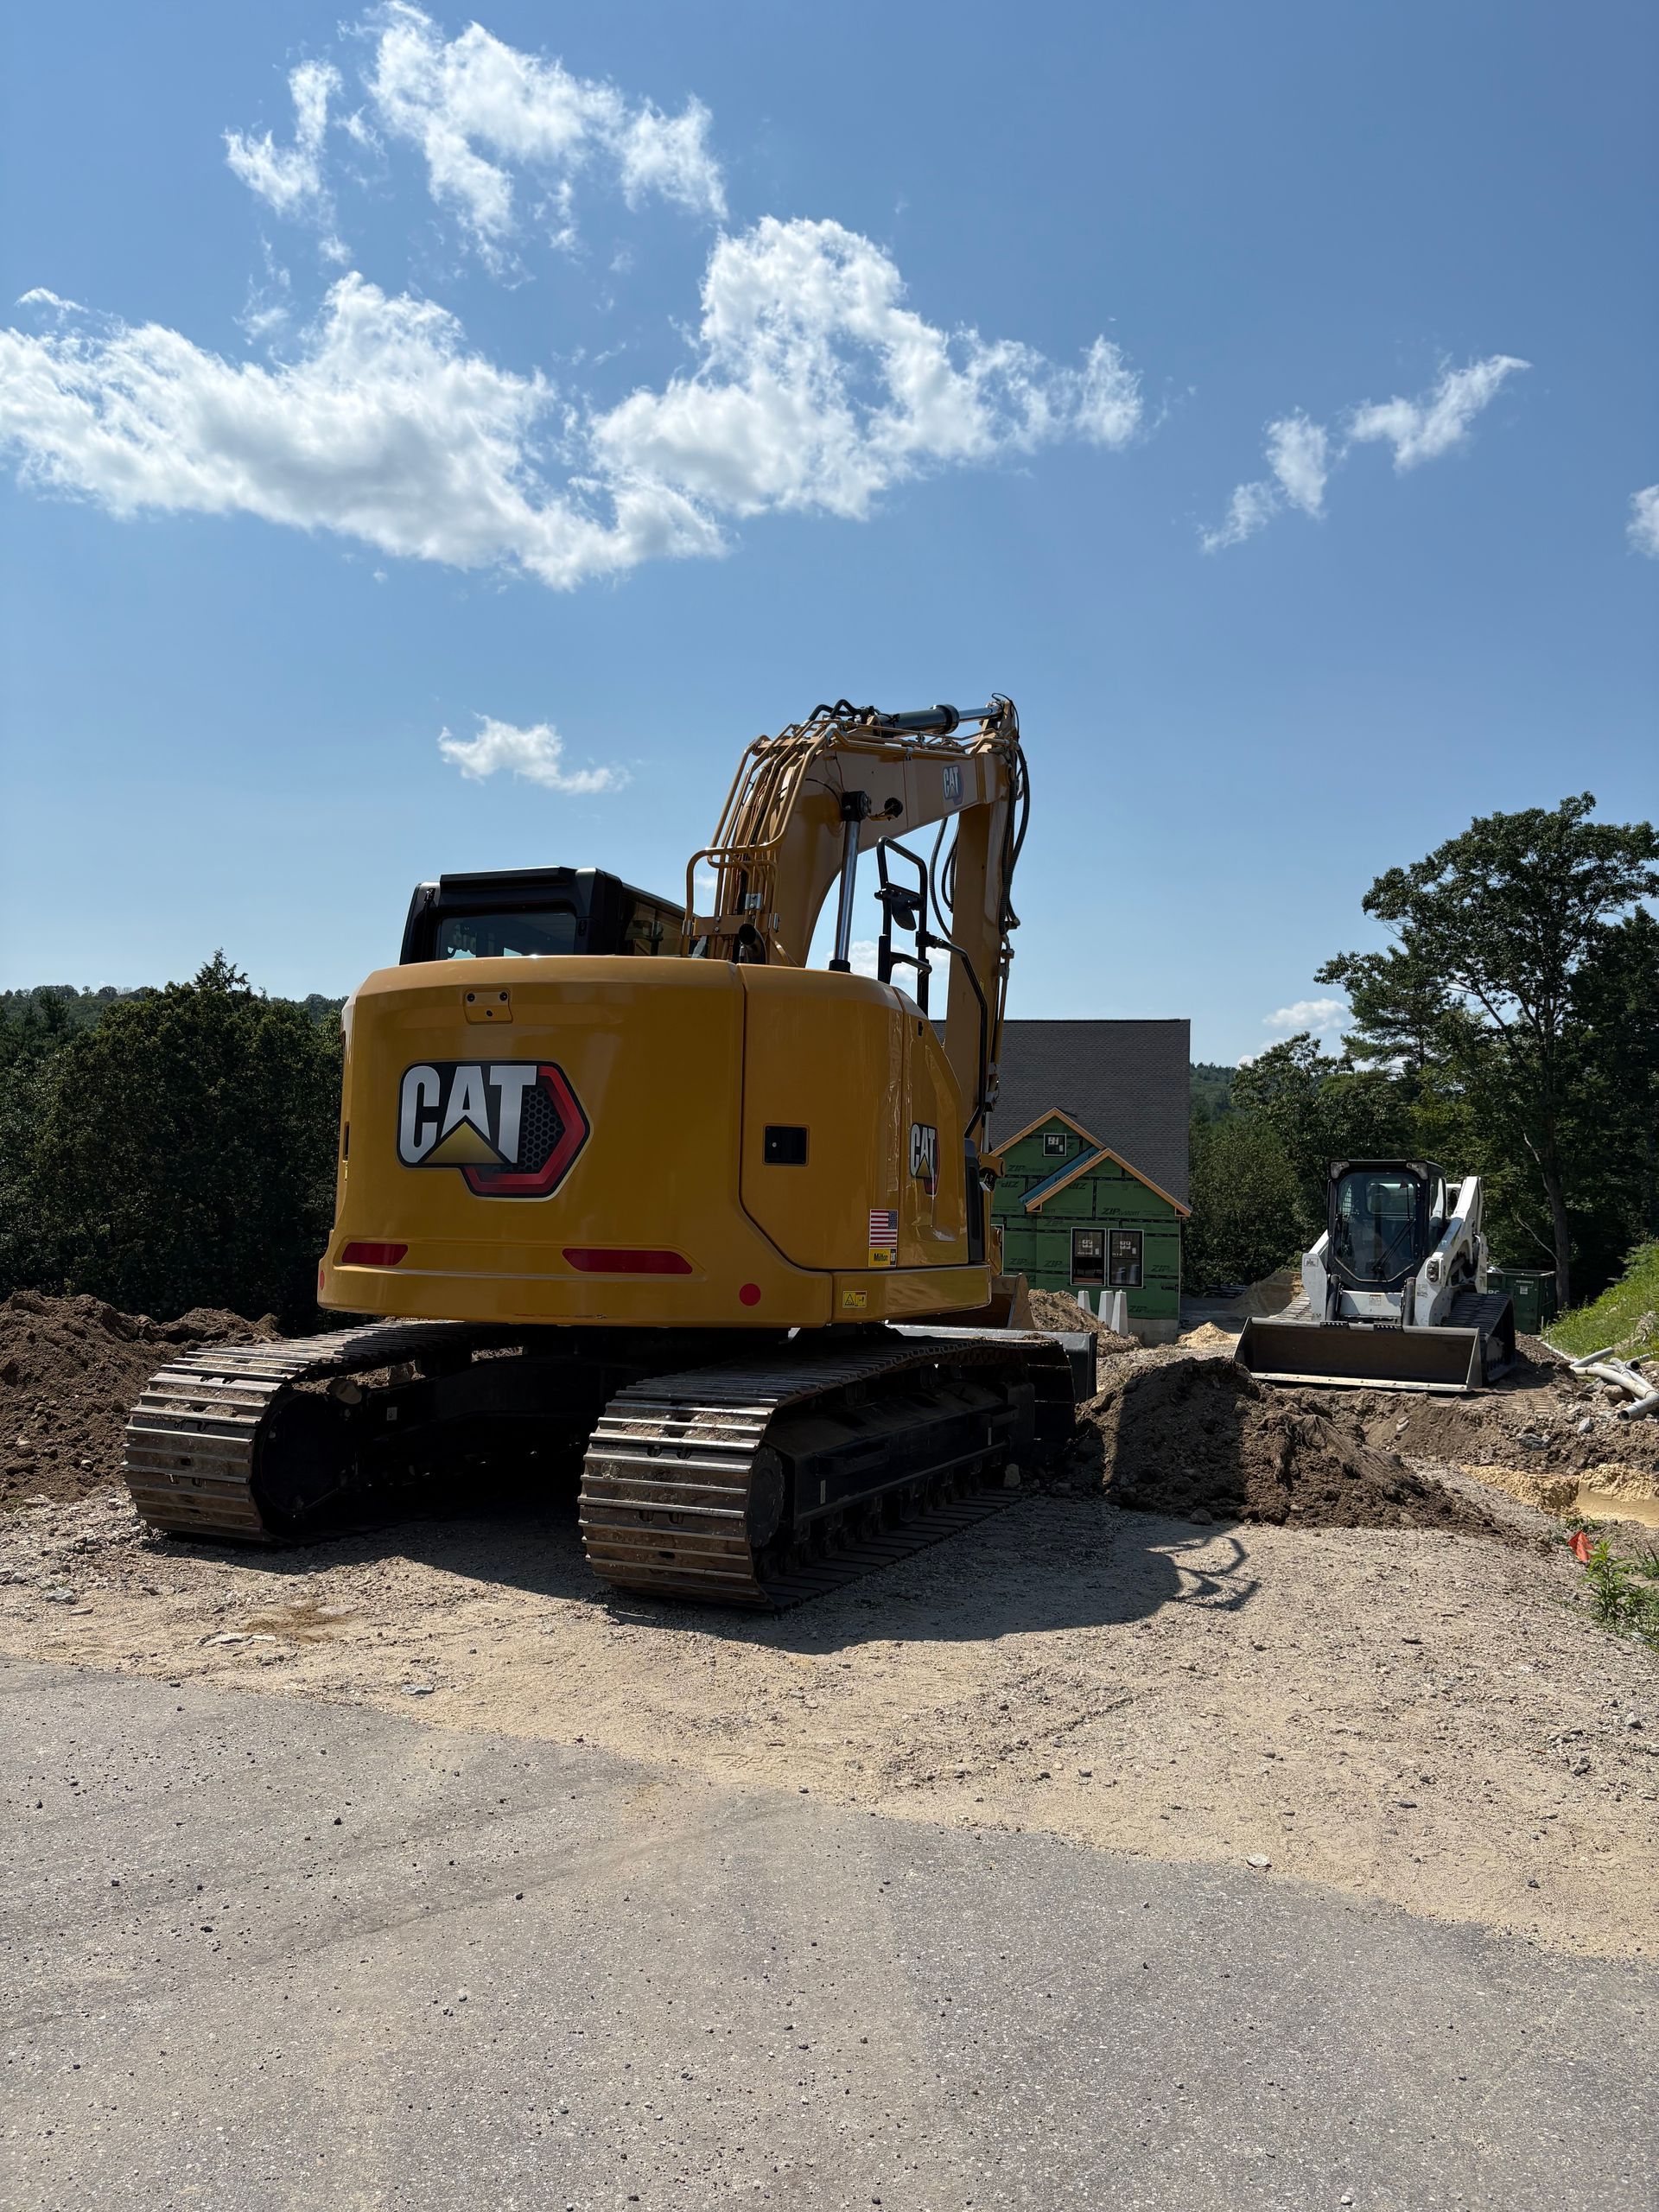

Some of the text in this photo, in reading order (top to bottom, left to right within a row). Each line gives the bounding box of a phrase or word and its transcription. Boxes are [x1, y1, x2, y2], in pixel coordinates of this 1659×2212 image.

[944, 766, 959, 798] CAT
[401, 1065, 537, 1164] CAT
[911, 1124, 936, 1177] CAT
